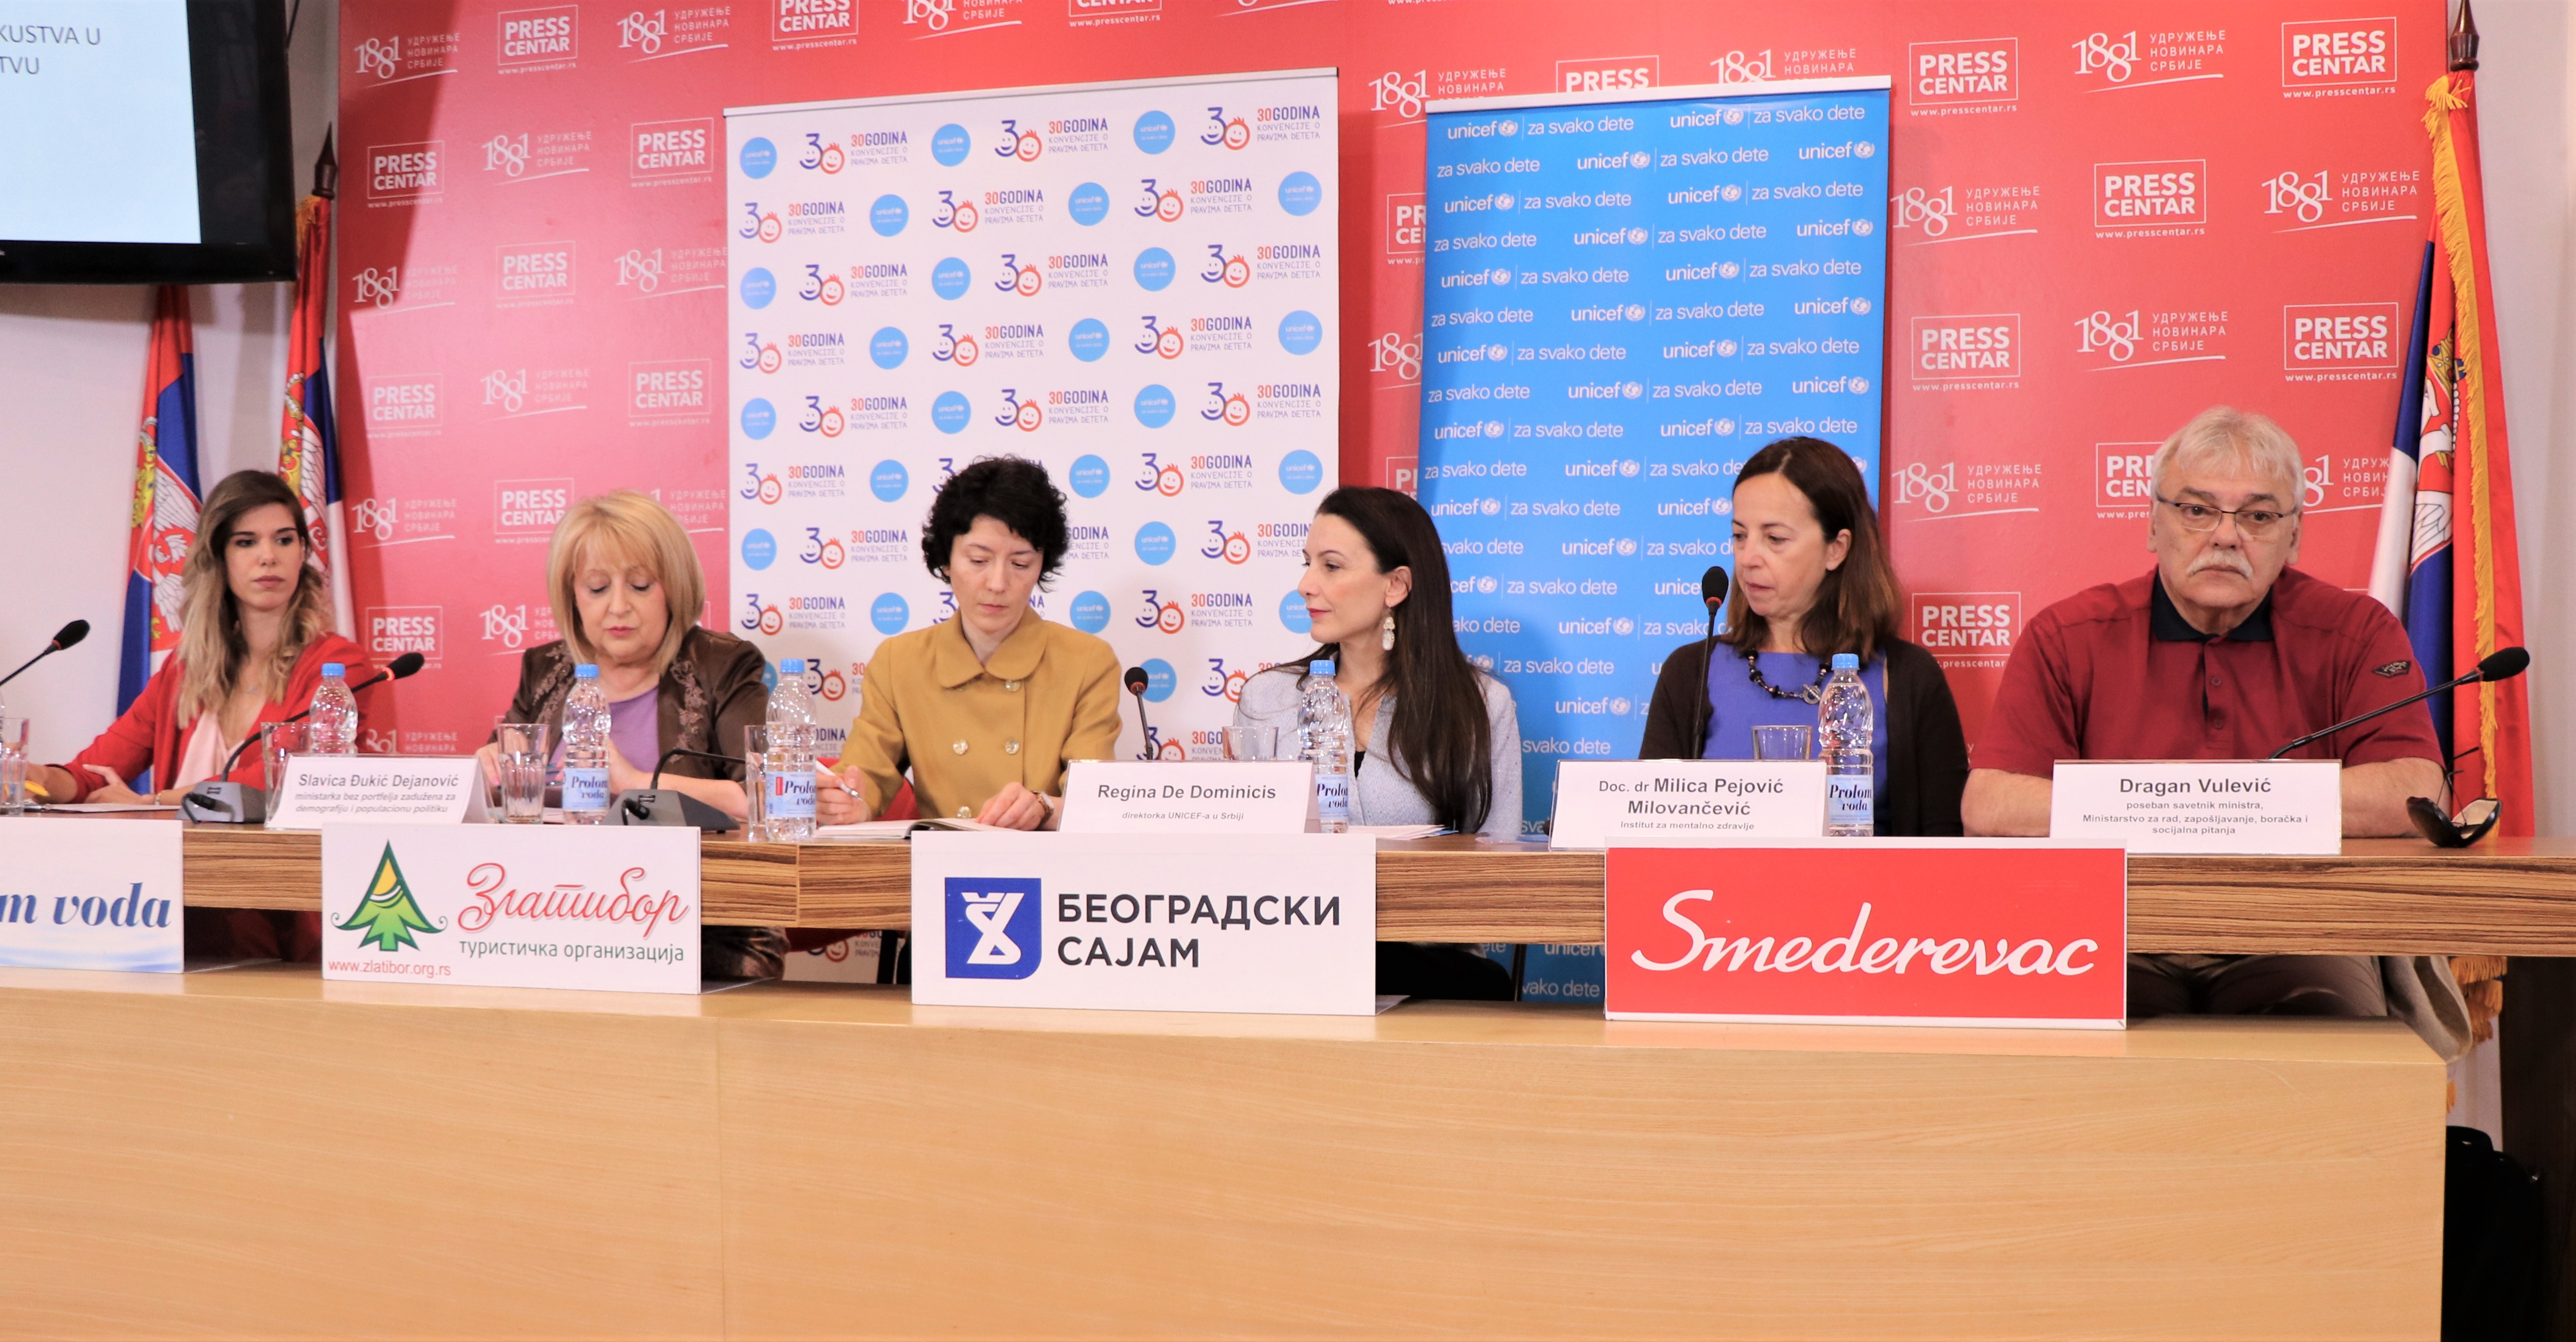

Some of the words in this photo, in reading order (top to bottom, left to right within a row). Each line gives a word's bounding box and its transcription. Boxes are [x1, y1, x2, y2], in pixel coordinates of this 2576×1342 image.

[675, 6, 730, 20] УДРУЖЕЊЕ
[506, 17, 570, 41] PRESS
[617, 9, 668, 54] 1881
[674, 19, 729, 31] НОВИНАРА
[86, 28, 100, 46] U
[674, 32, 712, 44] СРБИЈЕ
[2150, 30, 2226, 45] УДРУЖЕЊЕ
[2294, 30, 2385, 56] PRESS
[505, 37, 570, 56] CENTAR
[2150, 44, 2223, 57] НОВИНАРА
[1920, 50, 2007, 76] PRESS
[2071, 31, 2141, 82] 1881
[498, 62, 576, 75] www.presscentar.rs
[2150, 59, 2201, 72] СРБИЈЕ
[2292, 55, 2385, 76] CENTAR
[1919, 74, 2007, 95] CENTAR
[2283, 87, 2396, 98] www.presscentar.rs
[1670, 107, 1725, 128] unicef
[1754, 111, 1771, 123] za
[1776, 105, 1824, 122] svako
[1827, 104, 1865, 120] dete
[1911, 105, 2017, 117] www.presscentar.rs
[1257, 122, 1309, 131] KONVENCIJE
[1448, 120, 1498, 139] unicef
[1528, 123, 1545, 135] za
[1548, 117, 1594, 134] svako
[1598, 116, 1634, 131] dete
[638, 128, 705, 152] PRESS
[1257, 133, 1288, 142] PRAVIMA
[1291, 131, 1320, 140] DETETA
[1577, 151, 1629, 170] unicef
[1660, 154, 1677, 167] za
[1682, 148, 1728, 165] svako
[1732, 146, 1769, 163] dete
[1799, 141, 1852, 159] unicef
[638, 150, 704, 169] CENTAR
[1437, 165, 1453, 178] za
[1456, 158, 1501, 175] svako
[1504, 157, 1540, 172] dete
[631, 177, 713, 188] www.presscentar.rs
[2106, 172, 2195, 197] PRESS
[2342, 170, 2419, 185] УДРУЖЕЊЕ
[2261, 170, 2333, 223] 1881
[2342, 185, 2417, 197] НОВИНАРА
[2105, 197, 2195, 217] CENTAR
[2342, 200, 2394, 212] СРБИЈЕ
[2095, 228, 2205, 239] www.presscentar.rs
[2153, 311, 2228, 325] УДРУЖЕЊЕ
[2074, 310, 2144, 362] 1881
[2153, 326, 2226, 337] НОВИНАРА
[2295, 316, 2387, 340] PRESS
[1922, 326, 2010, 350] PRESS
[2153, 340, 2204, 352] СРБИЈЕ
[2295, 340, 2387, 360] CENTAR
[1921, 351, 2010, 370] CENTAR
[2285, 371, 2397, 383] www.presscentar.rs
[1913, 382, 2019, 391] www.presscentar.rs
[1967, 464, 2041, 477] УДРУЖЕЊЕ
[1892, 462, 1959, 513] 1881
[1967, 478, 2039, 489] НОВИНАРА
[1967, 492, 2017, 503] СРБИЈЕ
[1431, 499, 1480, 516] unicef
[1511, 503, 1528, 515] za
[1532, 499, 1580, 516] svako
[1583, 499, 1620, 516] dete
[1191, 609, 1243, 618] KONVENCIJE
[373, 616, 435, 636] PRESS
[1559, 617, 1612, 634] unicef
[373, 636, 436, 653] CENTAR
[1521, 738, 1570, 755] svako
[1574, 737, 1611, 755] dete
[299, 773, 346, 786] Slavica
[350, 774, 388, 787] Đukić
[392, 774, 459, 790] Dejanović
[1599, 780, 1629, 792] Doc.
[1635, 781, 1649, 792] dr
[1654, 778, 1707, 793] Milica
[1715, 778, 1783, 797] Pejović
[2120, 778, 2191, 797] Dragan
[2198, 778, 2271, 793] Vulević
[361, 792, 399, 803] portfelja
[400, 792, 443, 801] zadužena
[1098, 784, 1156, 802] Regina
[1162, 785, 1184, 799] De
[1190, 785, 1276, 799] Dominicis
[1829, 784, 1872, 798] Prolom
[295, 804, 349, 814] demografiju
[355, 805, 412, 814] populacionu
[413, 805, 448, 814] politiku
[1628, 800, 1750, 815] Milovančević
[1842, 800, 1867, 811] voda
[2126, 801, 2170, 811] poseban
[2218, 801, 2263, 810] ministra,
[1220, 812, 1244, 821] Srbiji
[2083, 814, 2145, 822] Ministarstvo
[2184, 815, 2257, 824] zapošljavanje,
[1717, 822, 1754, 831] zdravlje
[2153, 826, 2198, 835] socijalna
[2201, 826, 2236, 835] pitanja
[53, 882, 171, 928] voda
[1058, 894, 1340, 931] БЕОГРАДСКИ
[1631, 889, 2099, 976] Smederevac
[459, 941, 558, 959] туристичка
[563, 944, 684, 965] организација
[1058, 936, 1199, 967] САЈАМ
[328, 959, 451, 979] www.zlatibor.org.rs
[1562, 980, 1600, 998] dete
